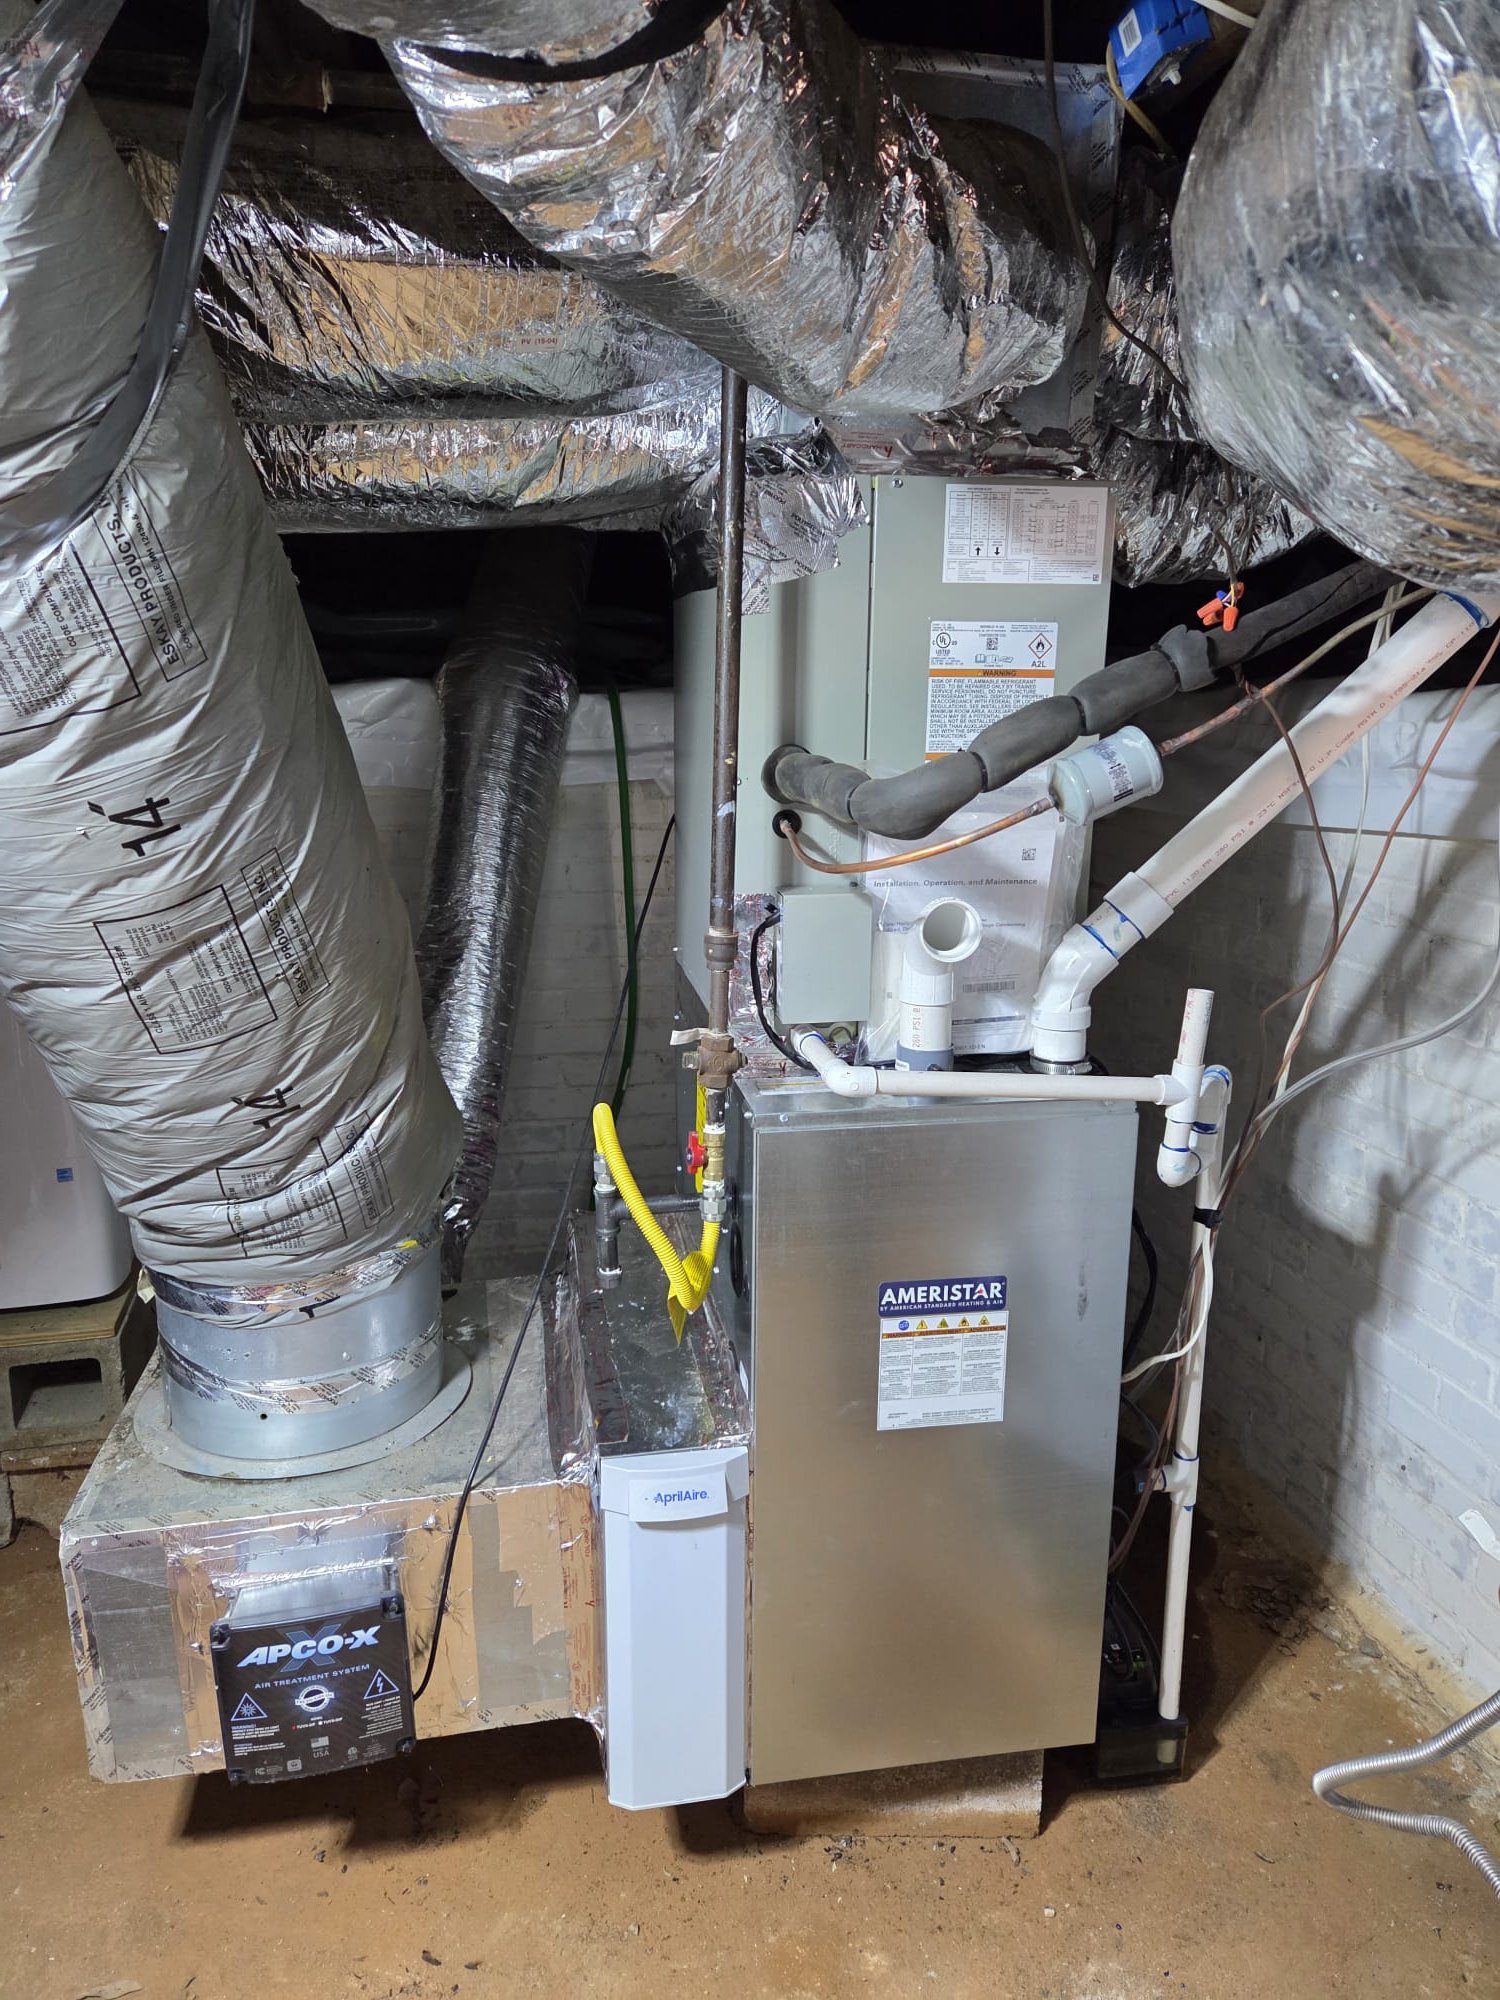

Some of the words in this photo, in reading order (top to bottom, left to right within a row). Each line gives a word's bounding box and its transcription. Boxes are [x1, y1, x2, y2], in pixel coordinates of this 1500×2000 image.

[104, 511, 158, 613] PRODUCTS,
[152, 563, 166, 583] FILE
[33, 565, 65, 623] COMPLIANCE
[60, 623, 76, 648] CODE
[149, 614, 180, 665] ESKAY
[250, 871, 269, 897] INC.
[873, 879, 920, 888] Installation,
[923, 878, 966, 888] Operation,
[968, 878, 984, 886] and
[986, 877, 1037, 885] Maintenance
[203, 937, 225, 978] COMPLIANCE
[287, 960, 309, 994] ESKAY
[136, 993, 148, 1008] AIR
[913, 1017, 921, 1031] PSI
[881, 1283, 1002, 1304] AMERISTAR
[656, 1489, 708, 1506] AprilAire
[236, 1625, 380, 1668] APCO-X
[254, 1682, 271, 1690] AIR
[274, 1673, 330, 1687] TREATMENT
[332, 1664, 370, 1676] SYSTEM
[313, 1749, 330, 1758] USA
